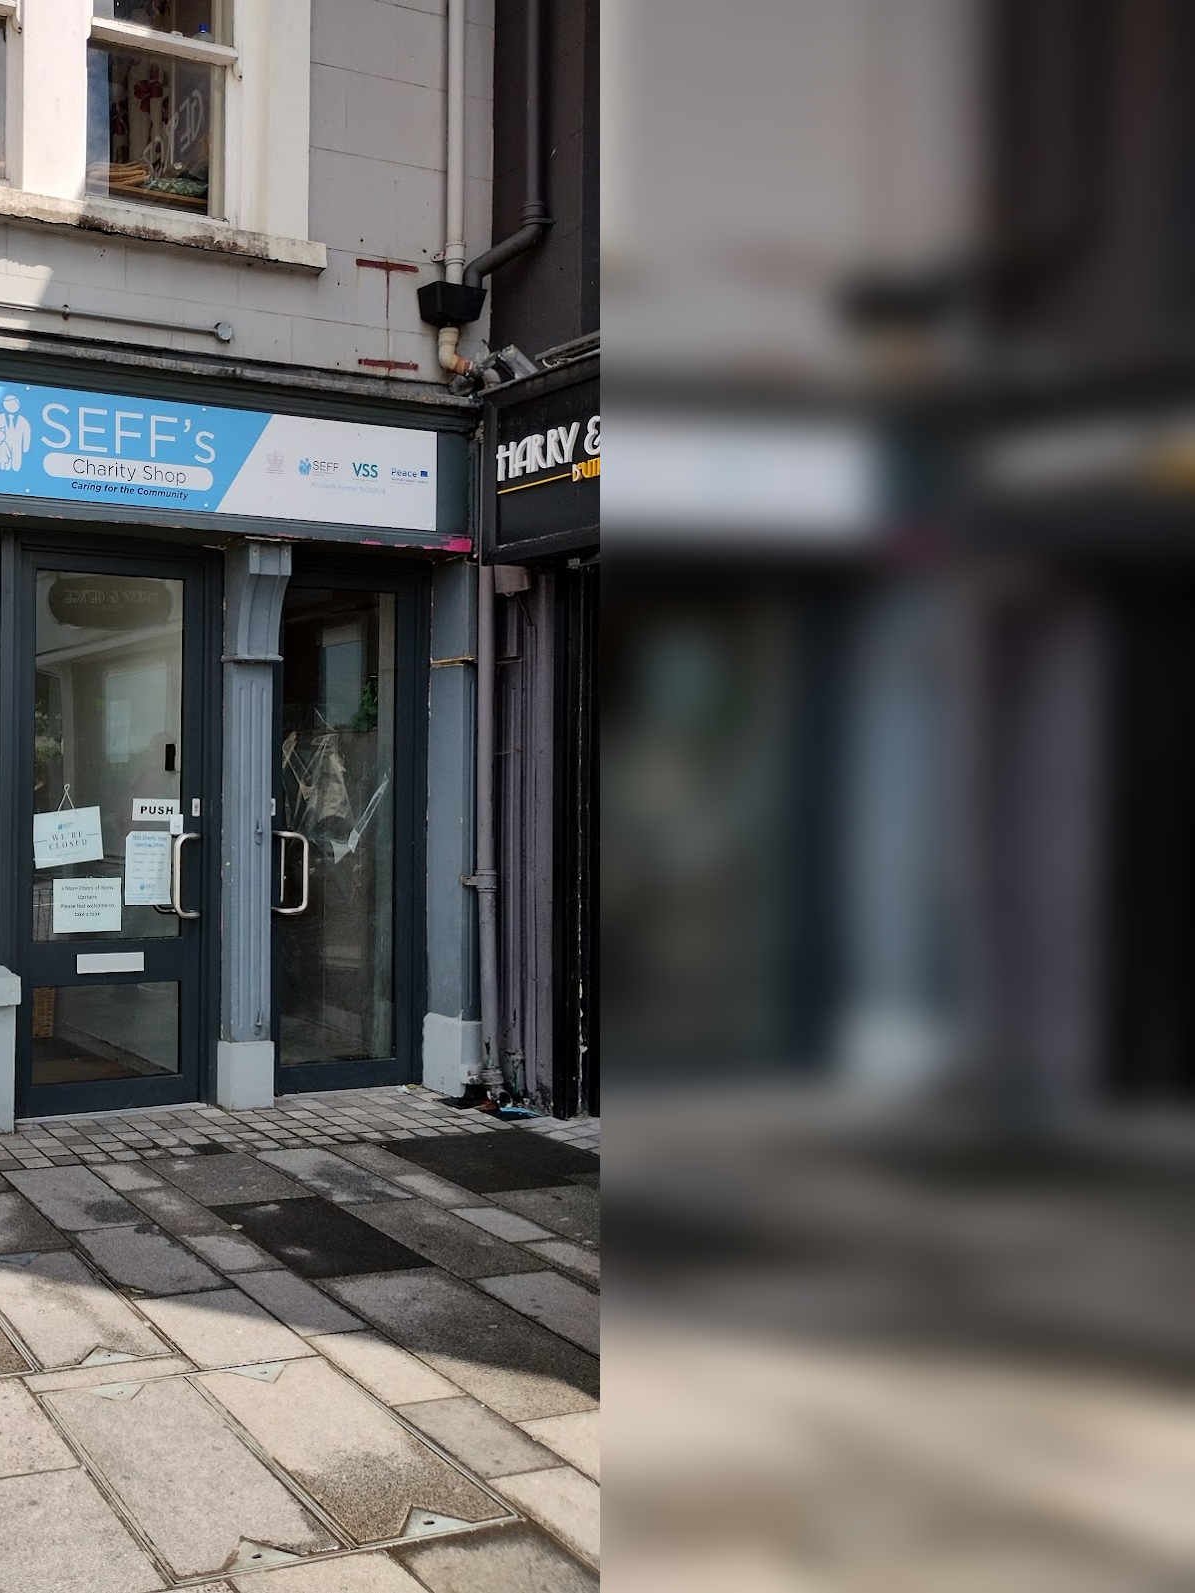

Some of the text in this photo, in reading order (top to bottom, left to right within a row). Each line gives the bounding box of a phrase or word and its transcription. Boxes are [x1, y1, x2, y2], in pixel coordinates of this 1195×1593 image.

[41, 403, 216, 464] SEFF's
[496, 422, 580, 481] HARRY
[72, 458, 187, 486] Charity Shop
[313, 460, 417, 478] SEFF VSS Peace
[71, 481, 189, 500] Caring for the Community
[140, 805, 174, 815] PUSH
[48, 839, 87, 850] CLOSED
